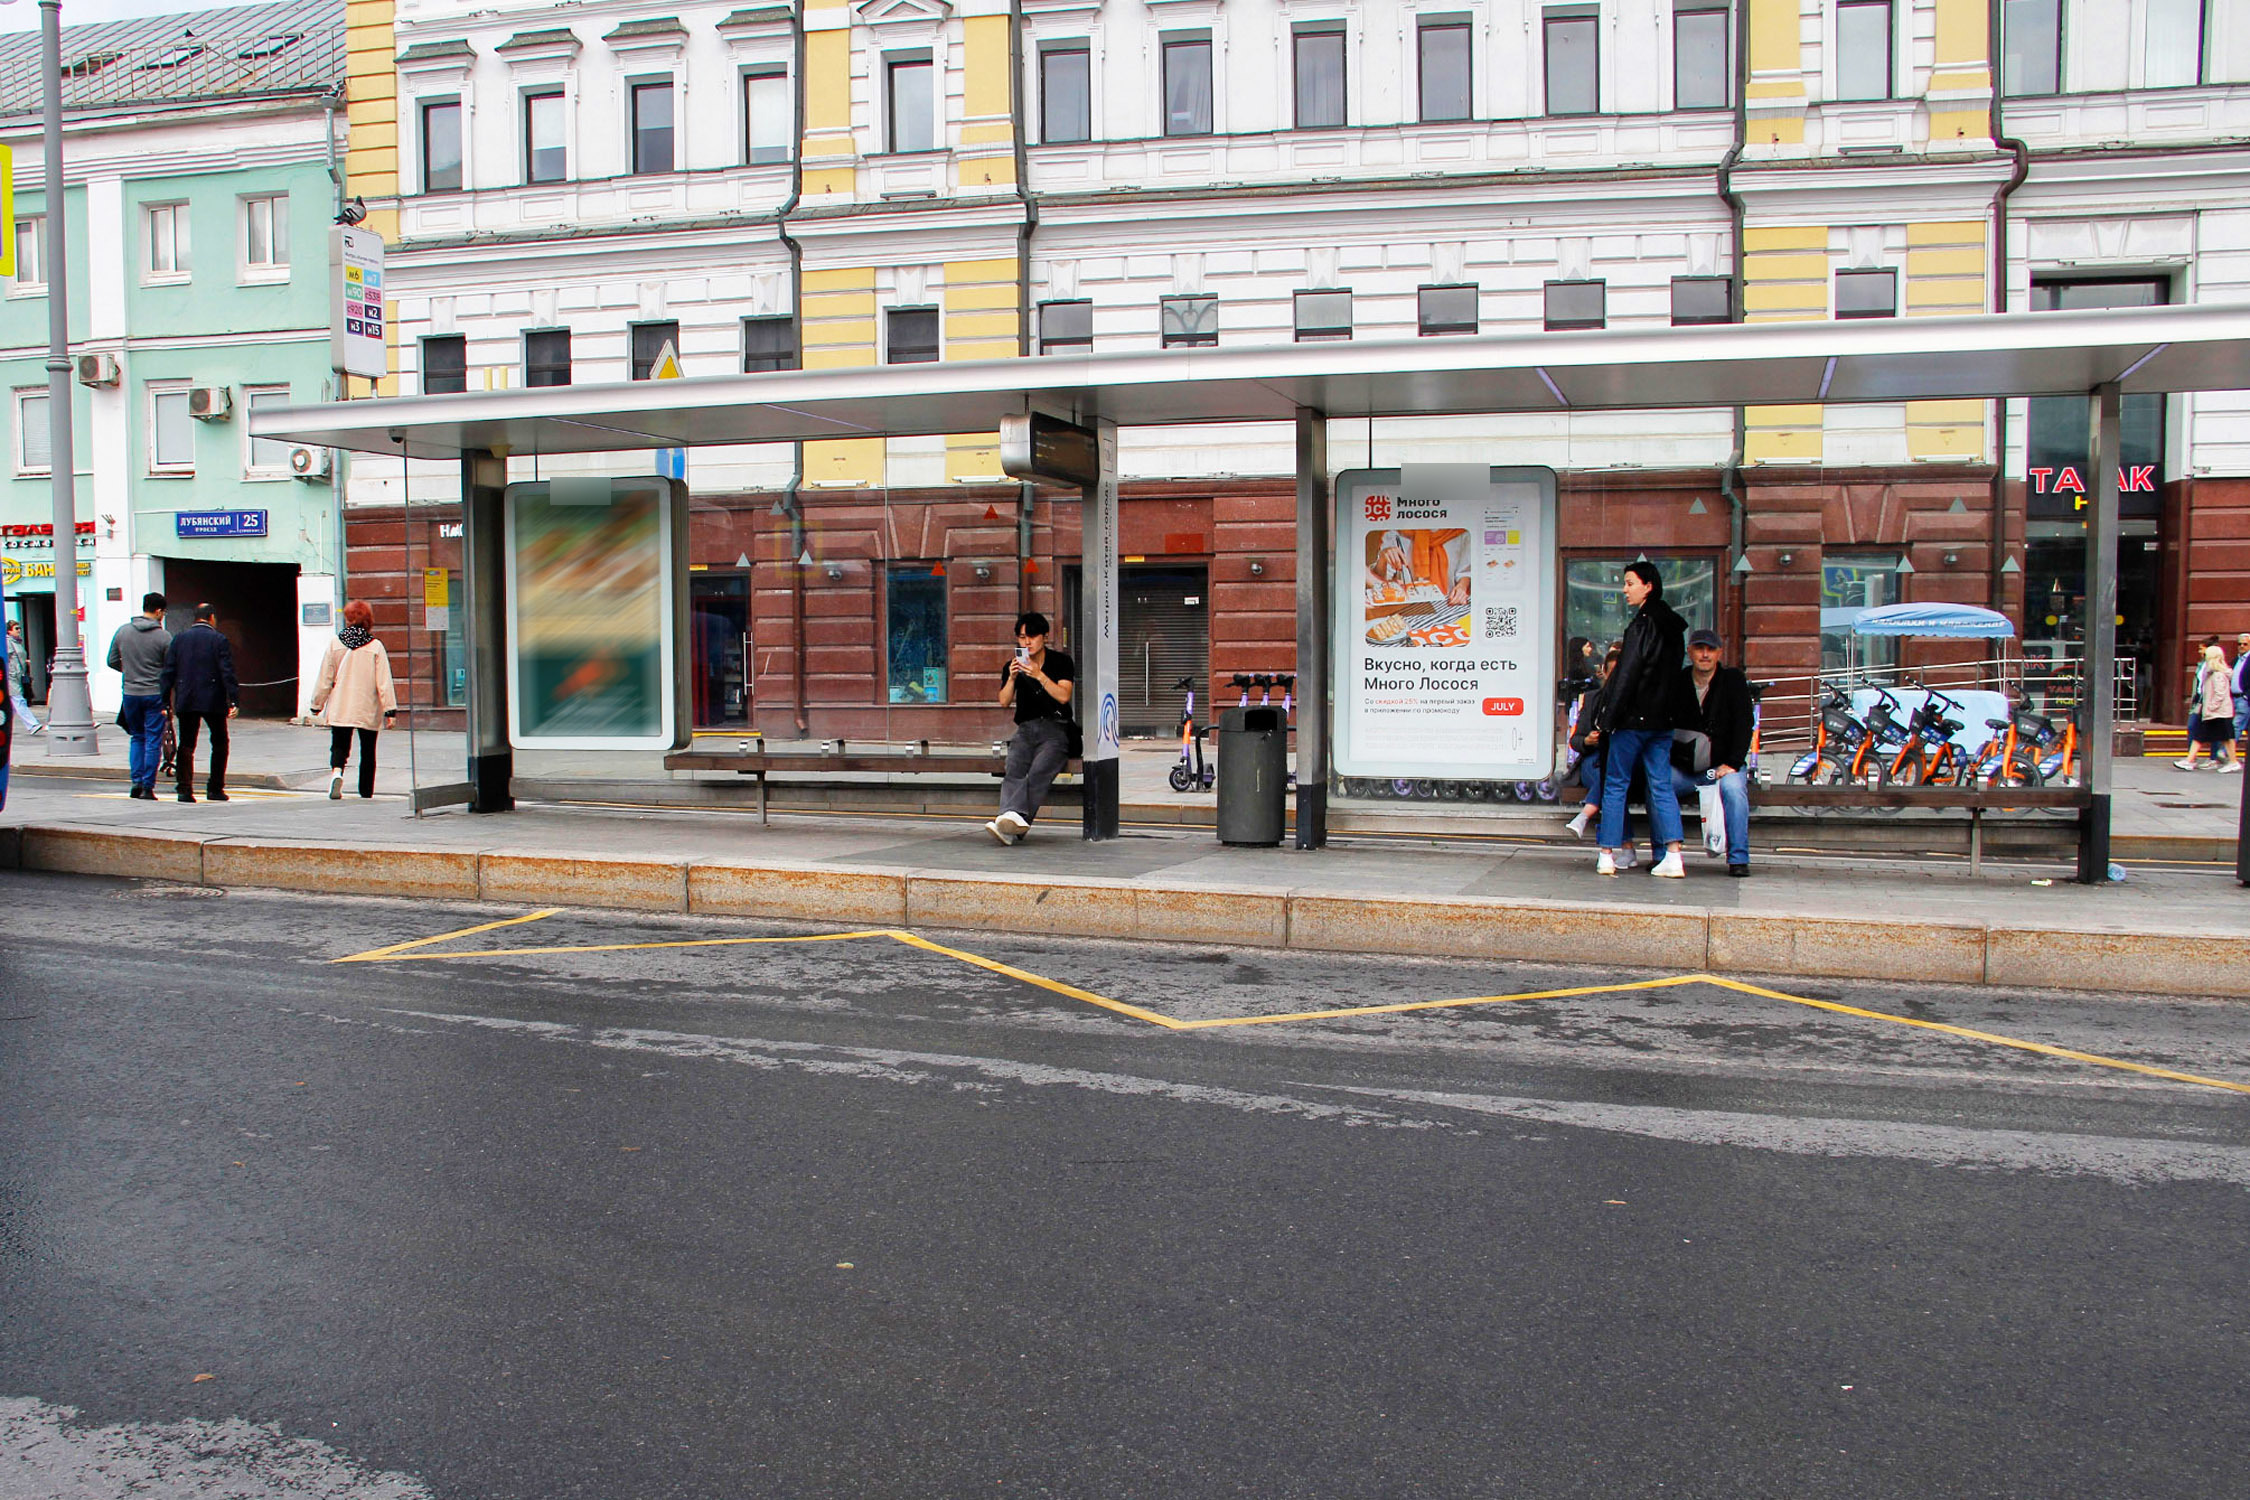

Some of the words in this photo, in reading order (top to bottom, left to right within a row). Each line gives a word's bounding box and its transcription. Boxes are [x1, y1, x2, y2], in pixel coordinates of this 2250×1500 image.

[2029, 465, 2155, 494] ТАК
[180, 515, 232, 526] ЛУБЯНСКИЙ
[243, 514, 258, 527] 25
[1396, 509, 1447, 519] лосося
[26, 562, 56, 577] БАН
[1364, 657, 1426, 673] Вкусно,
[1430, 660, 1475, 672] когда
[1480, 660, 1518, 671] есть
[1364, 677, 1415, 691] Много
[1419, 677, 1479, 691] Лосося
[1490, 702, 1516, 711] JULY
